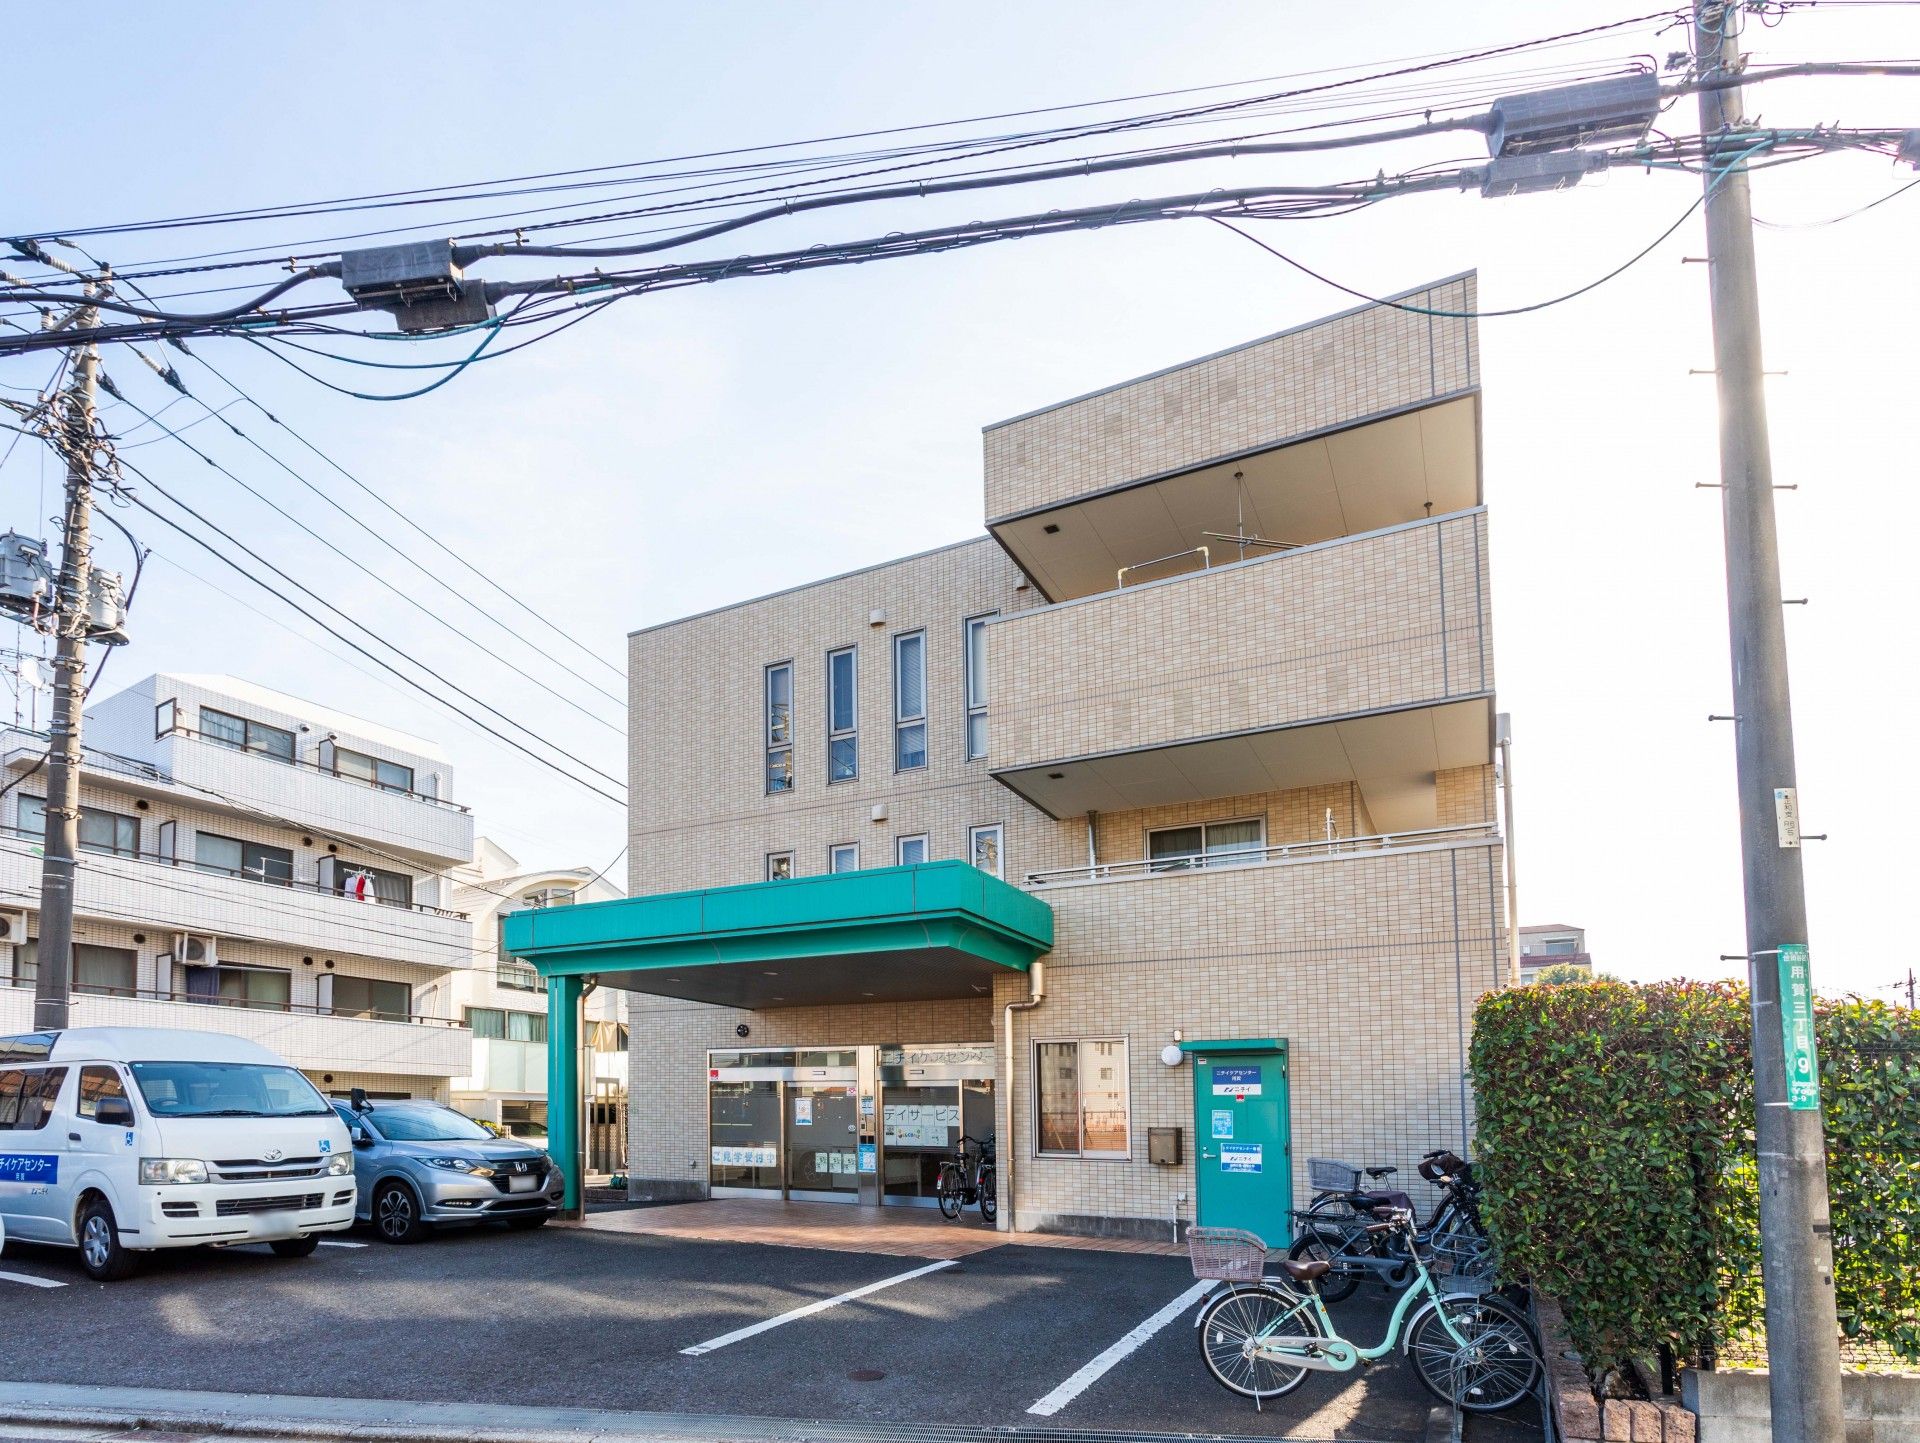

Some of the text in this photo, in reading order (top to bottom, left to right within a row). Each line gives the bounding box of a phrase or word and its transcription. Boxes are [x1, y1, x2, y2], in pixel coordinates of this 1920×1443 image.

[1791, 966, 1808, 1049] 用賀三丁目
[1797, 1057, 1808, 1074] 9
[884, 1109, 959, 1121] デイサービス
[713, 1150, 775, 1164] ご見学受付中
